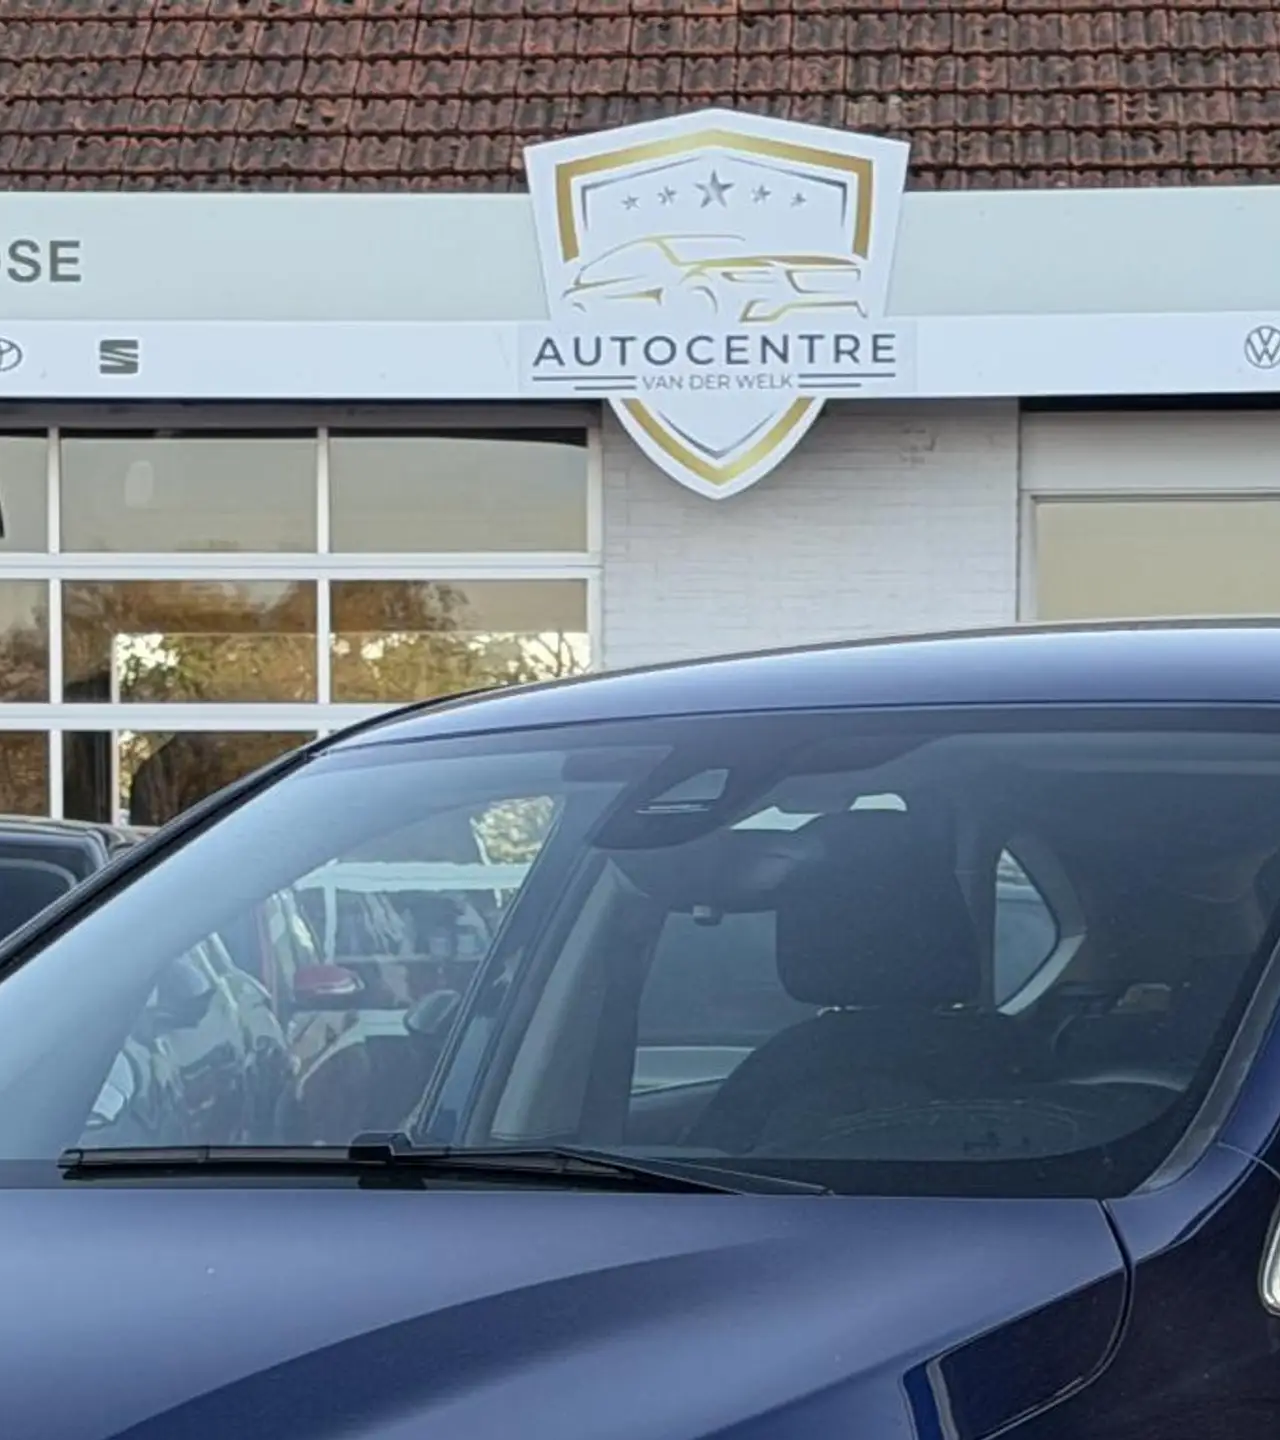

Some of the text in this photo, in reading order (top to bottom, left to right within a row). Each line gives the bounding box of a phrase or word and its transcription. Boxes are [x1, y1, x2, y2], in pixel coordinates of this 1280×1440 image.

[532, 334, 897, 367] AUTOCENTRE
[642, 372, 794, 391] VAN DER WELK
